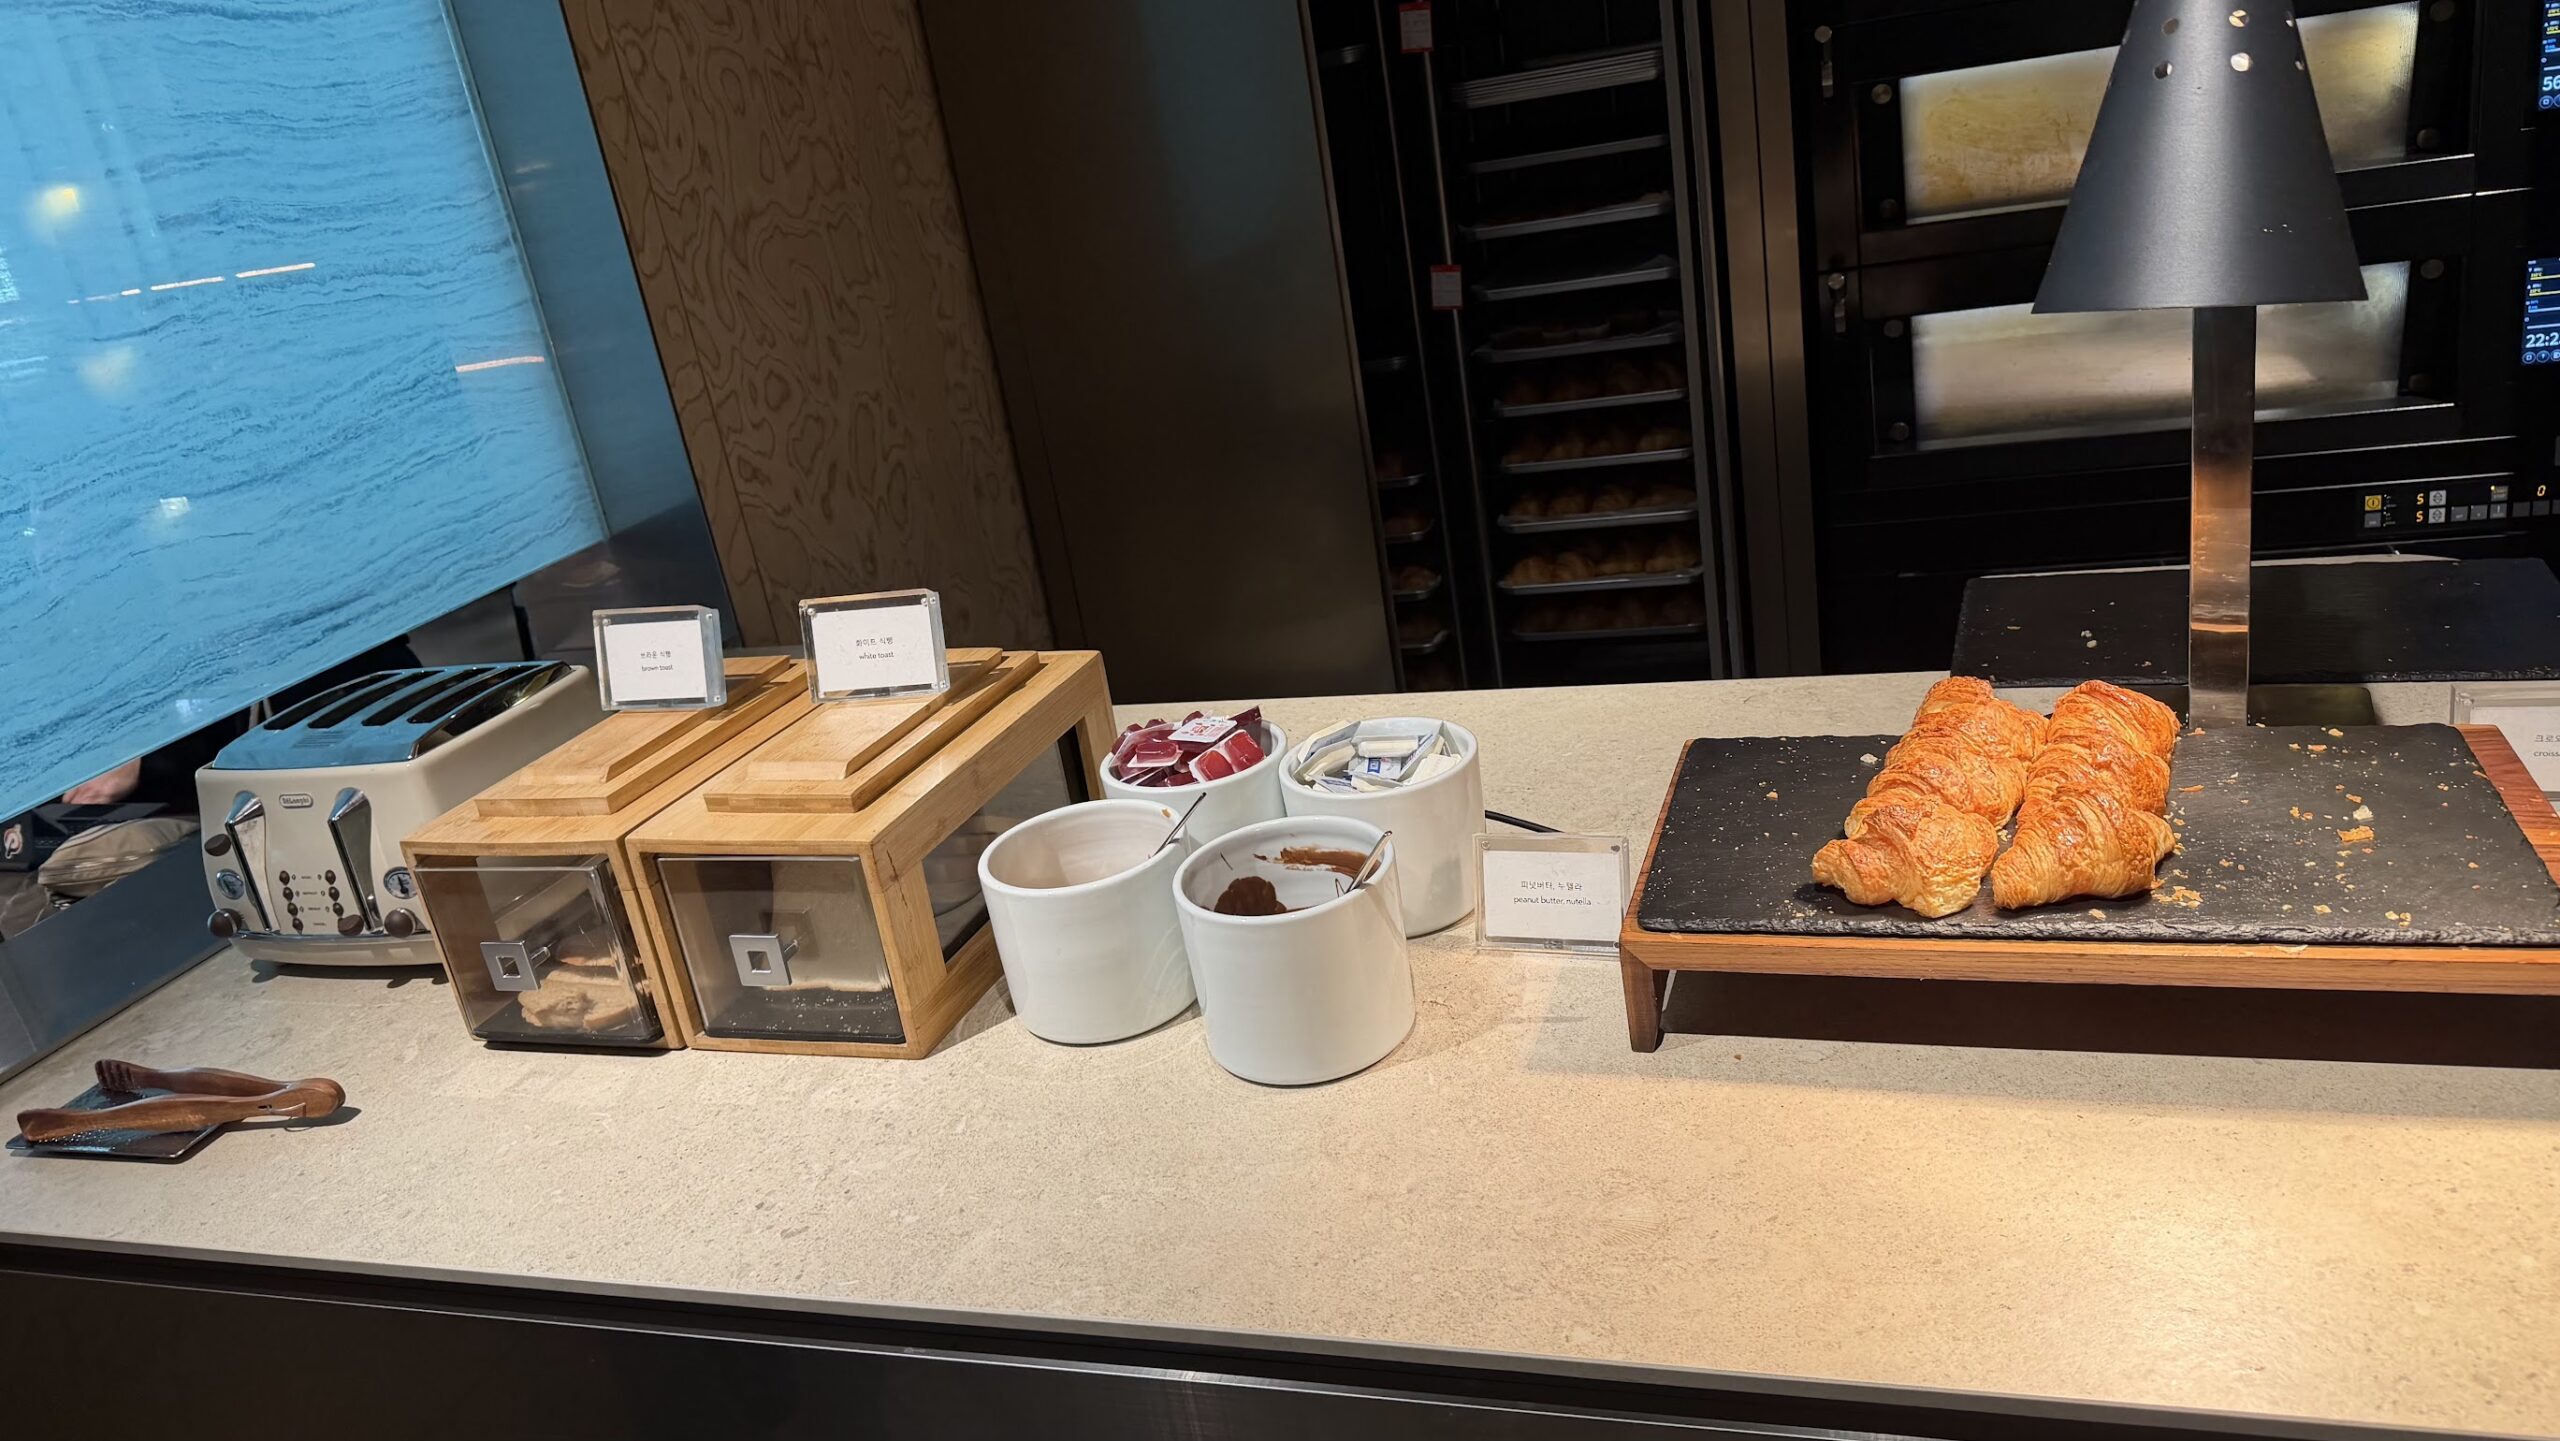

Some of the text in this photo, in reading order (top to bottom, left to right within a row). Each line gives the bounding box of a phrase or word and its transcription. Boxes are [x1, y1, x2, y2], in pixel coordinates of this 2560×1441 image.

[2525, 332, 2560, 348] 22:2
[859, 651, 894, 660] white toast
[1558, 881, 1583, 891] 누텔라
[1566, 897, 1592, 906] nutella
